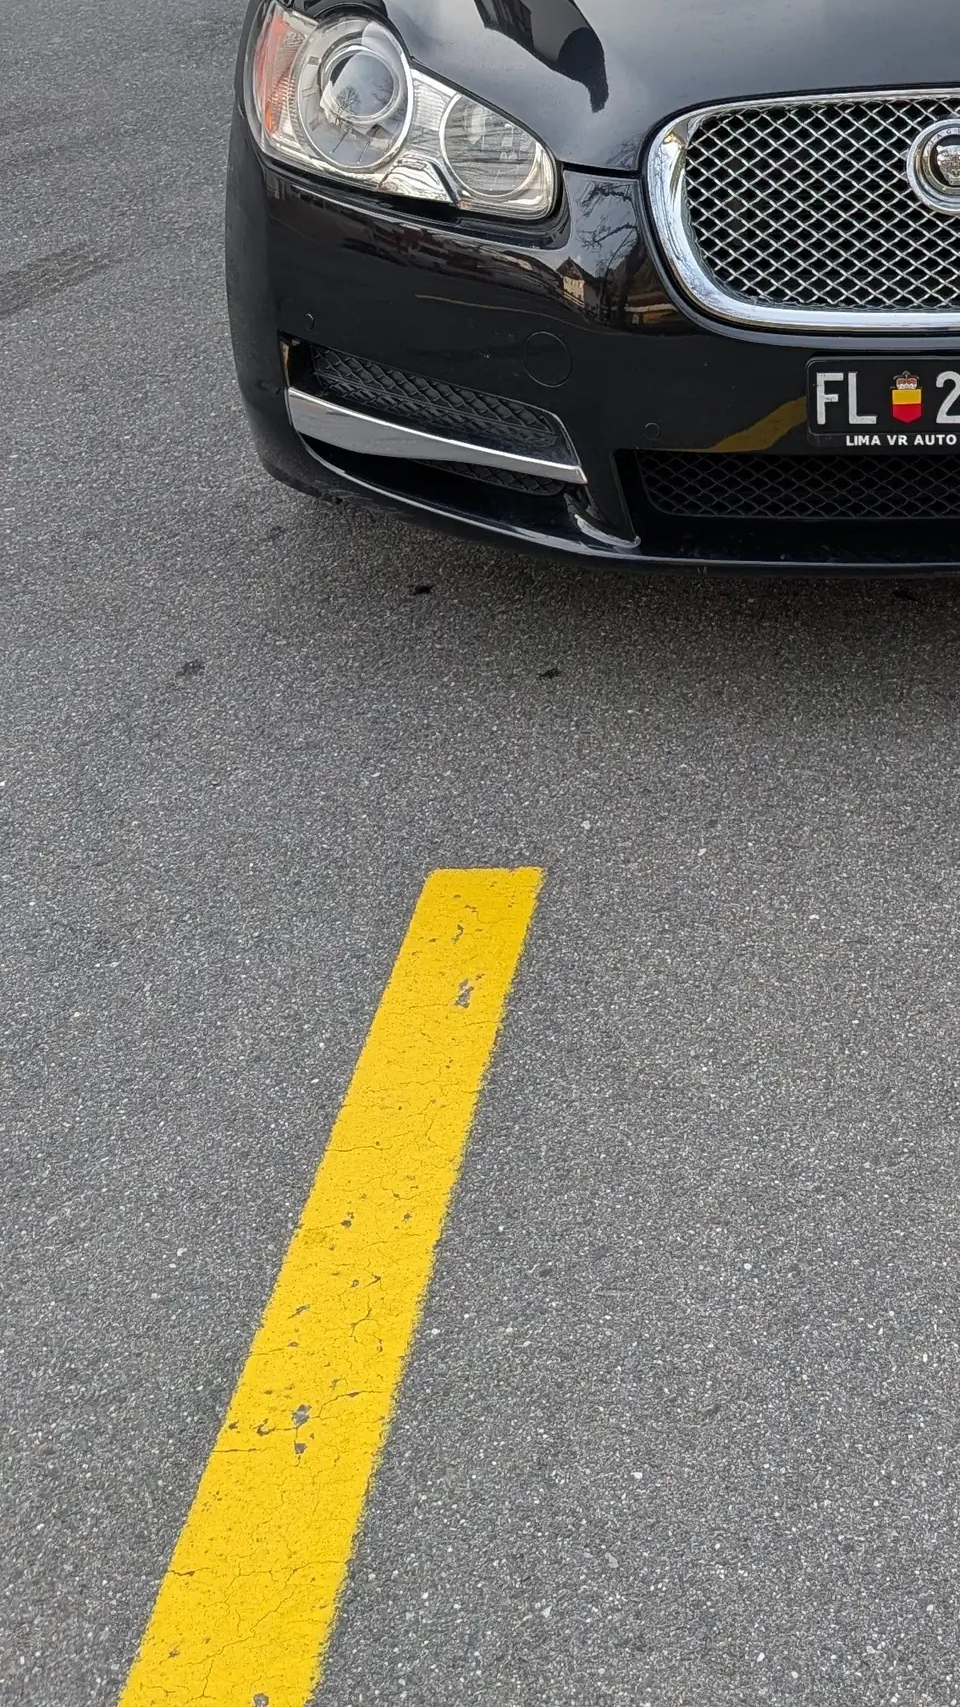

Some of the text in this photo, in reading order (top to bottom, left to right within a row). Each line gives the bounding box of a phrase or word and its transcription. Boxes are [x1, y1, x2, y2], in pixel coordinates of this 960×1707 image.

[815, 370, 878, 426] FL
[845, 434, 881, 447] LIMA
[886, 434, 909, 447] VR
[913, 433, 958, 446] AUTO
